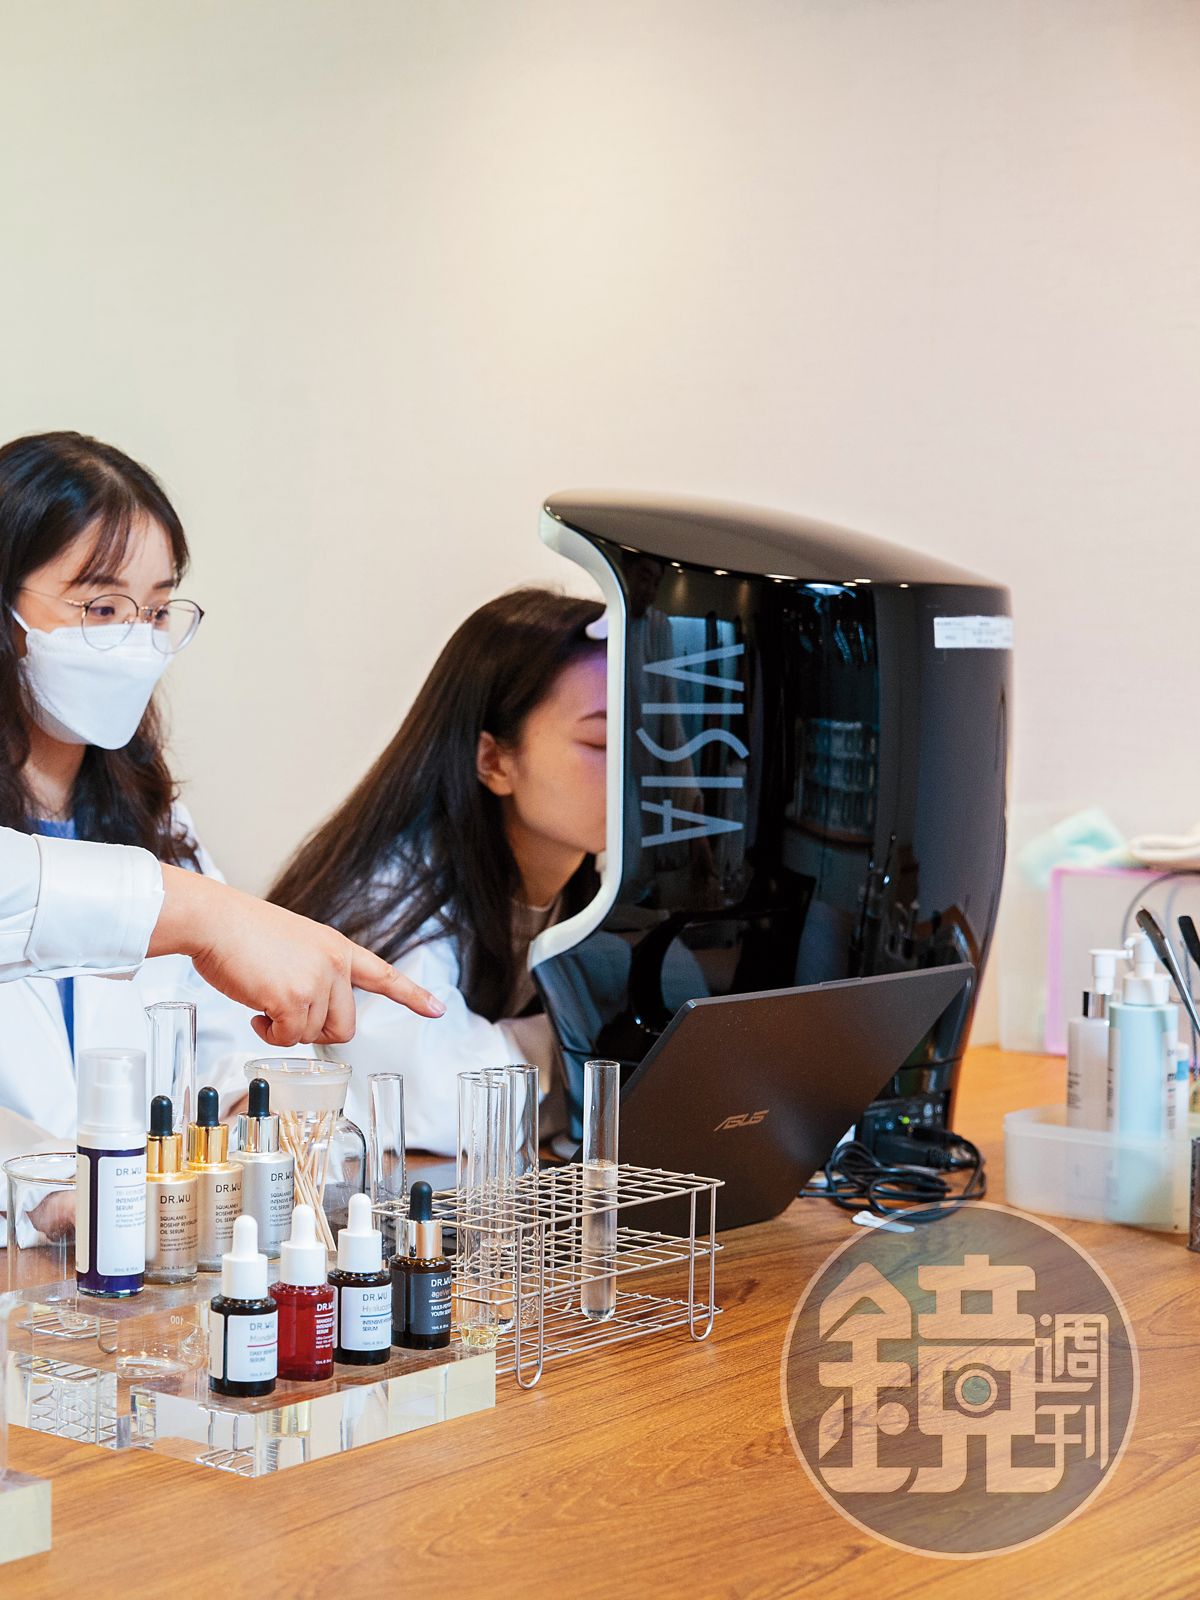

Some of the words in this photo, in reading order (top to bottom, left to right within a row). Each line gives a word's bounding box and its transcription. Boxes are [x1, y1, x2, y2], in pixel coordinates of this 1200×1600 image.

[636, 643, 749, 848] VISIA
[713, 1109, 769, 1131] ASUS
[116, 1167, 142, 1176] DR.WU
[216, 1183, 242, 1193] DR.WU
[160, 1194, 191, 1204] DR.WU
[363, 1292, 388, 1302] DR.WU
